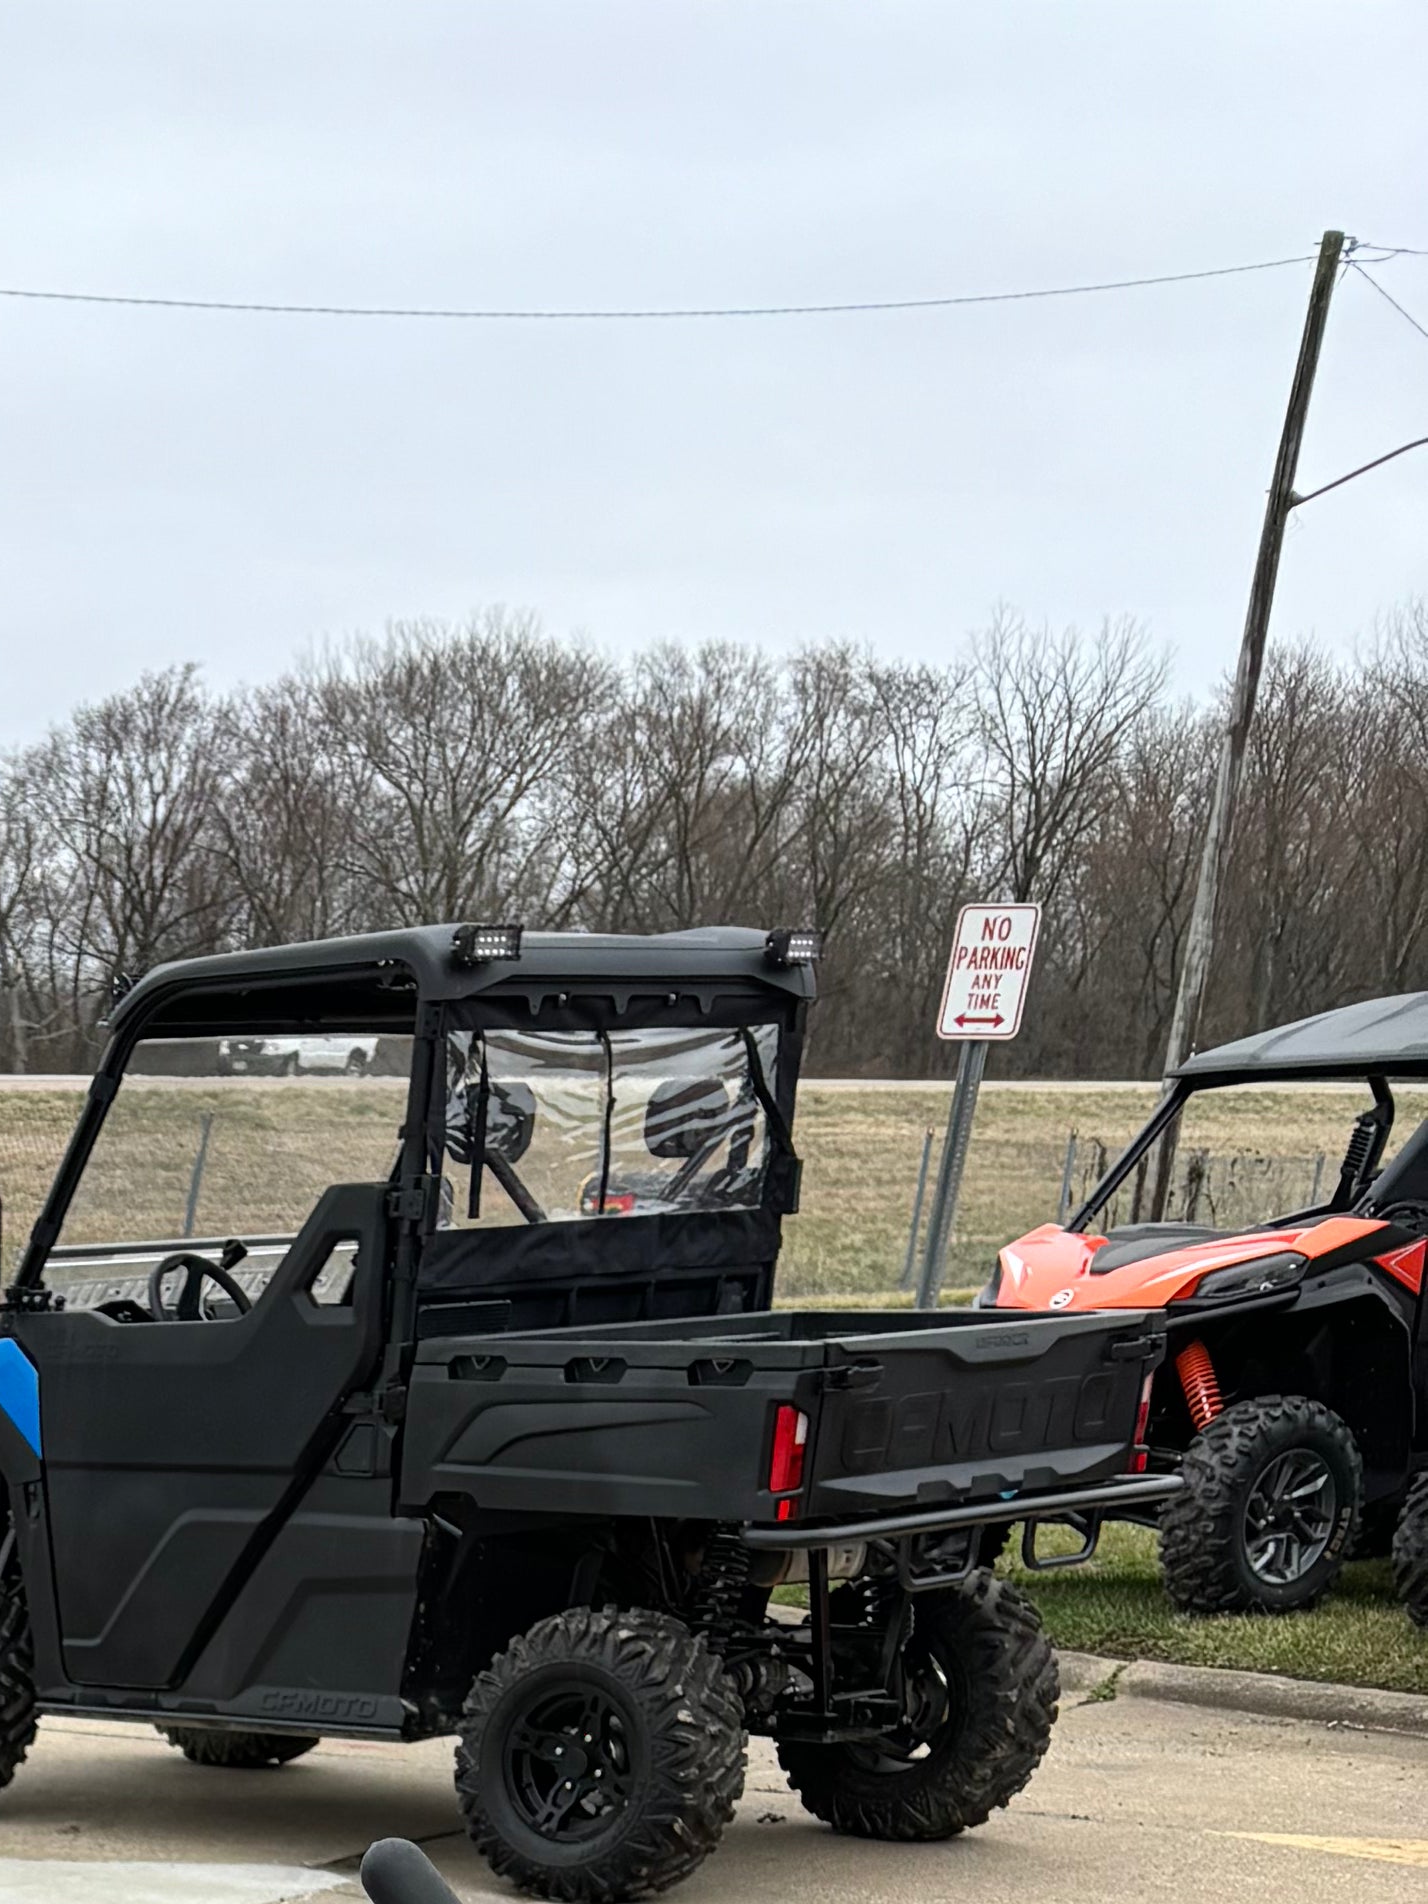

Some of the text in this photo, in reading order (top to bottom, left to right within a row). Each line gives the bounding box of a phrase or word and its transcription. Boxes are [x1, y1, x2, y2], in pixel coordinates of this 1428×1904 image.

[981, 916, 1012, 941] NO
[956, 946, 1026, 970] PARKING
[971, 974, 1003, 990] ANY
[967, 993, 1001, 1010] TIME
[839, 1371, 1118, 1473] CFMOTO
[259, 1691, 379, 1719] CFMOTO
